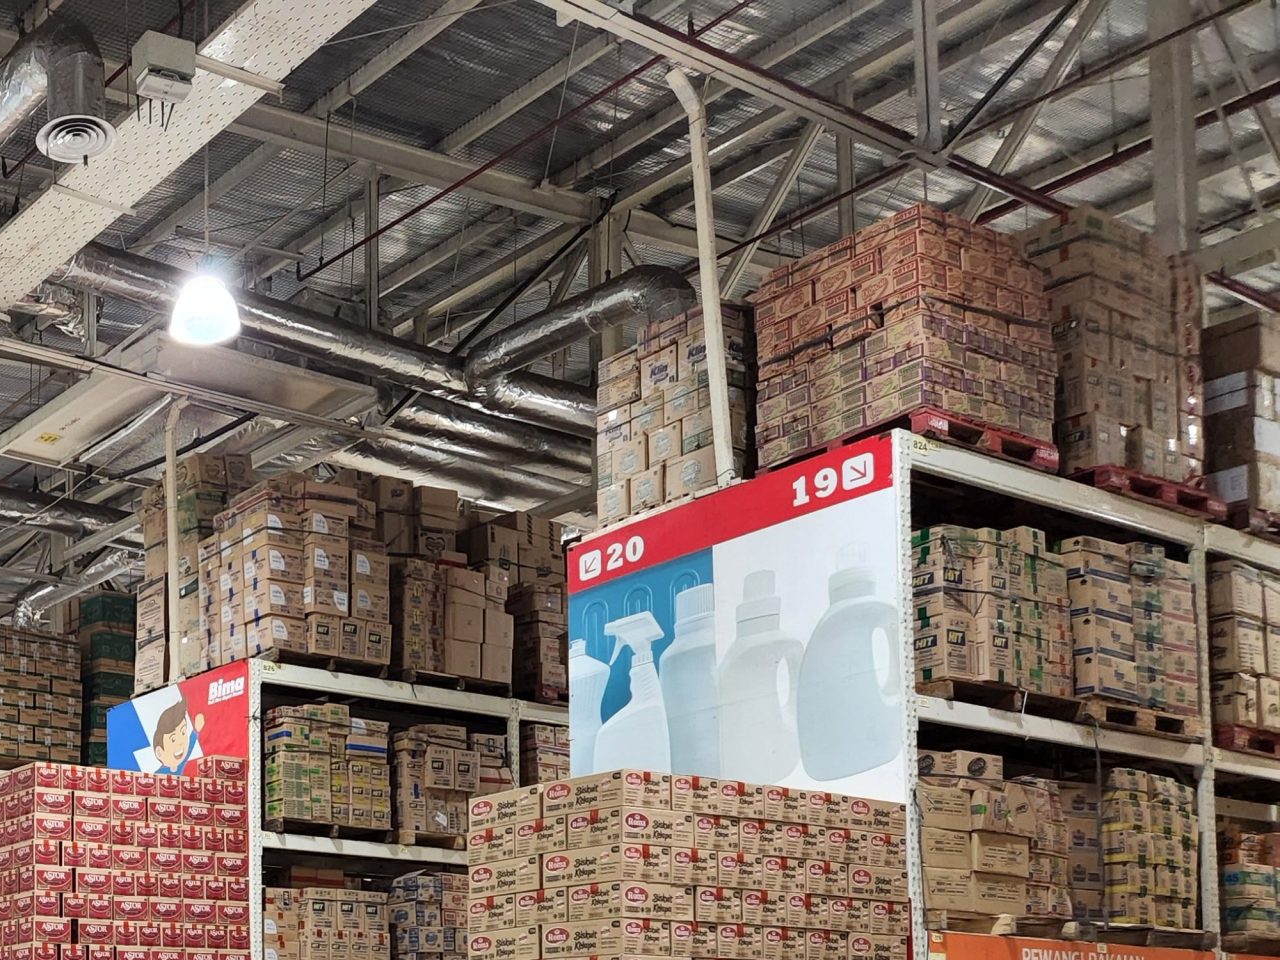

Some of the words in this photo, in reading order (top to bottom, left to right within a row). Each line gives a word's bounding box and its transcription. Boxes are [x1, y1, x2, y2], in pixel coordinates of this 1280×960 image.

[793, 467, 837, 506] 19
[606, 536, 644, 571] 20
[944, 569, 962, 583] HIT
[992, 577, 1005, 589] HIT
[318, 626, 328, 634] HIT
[948, 630, 965, 644] HIT
[994, 637, 1007, 648] HIT
[209, 677, 244, 699] Bima
[43, 794, 65, 803] ASTOR
[81, 797, 104, 806] ASTOR
[119, 801, 139, 809] ASTOR
[155, 804, 176, 812] ASTOR
[473, 805, 491, 814] Roma
[188, 807, 208, 815] ASTOR
[81, 822, 103, 831] ASTOR
[628, 818, 647, 827] Roma
[156, 853, 176, 861] ASTOR
[548, 860, 568, 869] Roma
[43, 871, 65, 880] ASTOR
[84, 874, 106, 883] ASTOR
[313, 903, 324, 911] HIT
[341, 903, 352, 911] HIT
[367, 905, 377, 914] HIT
[42, 922, 64, 931] ASTOR
[158, 952, 179, 960] ASTOR
